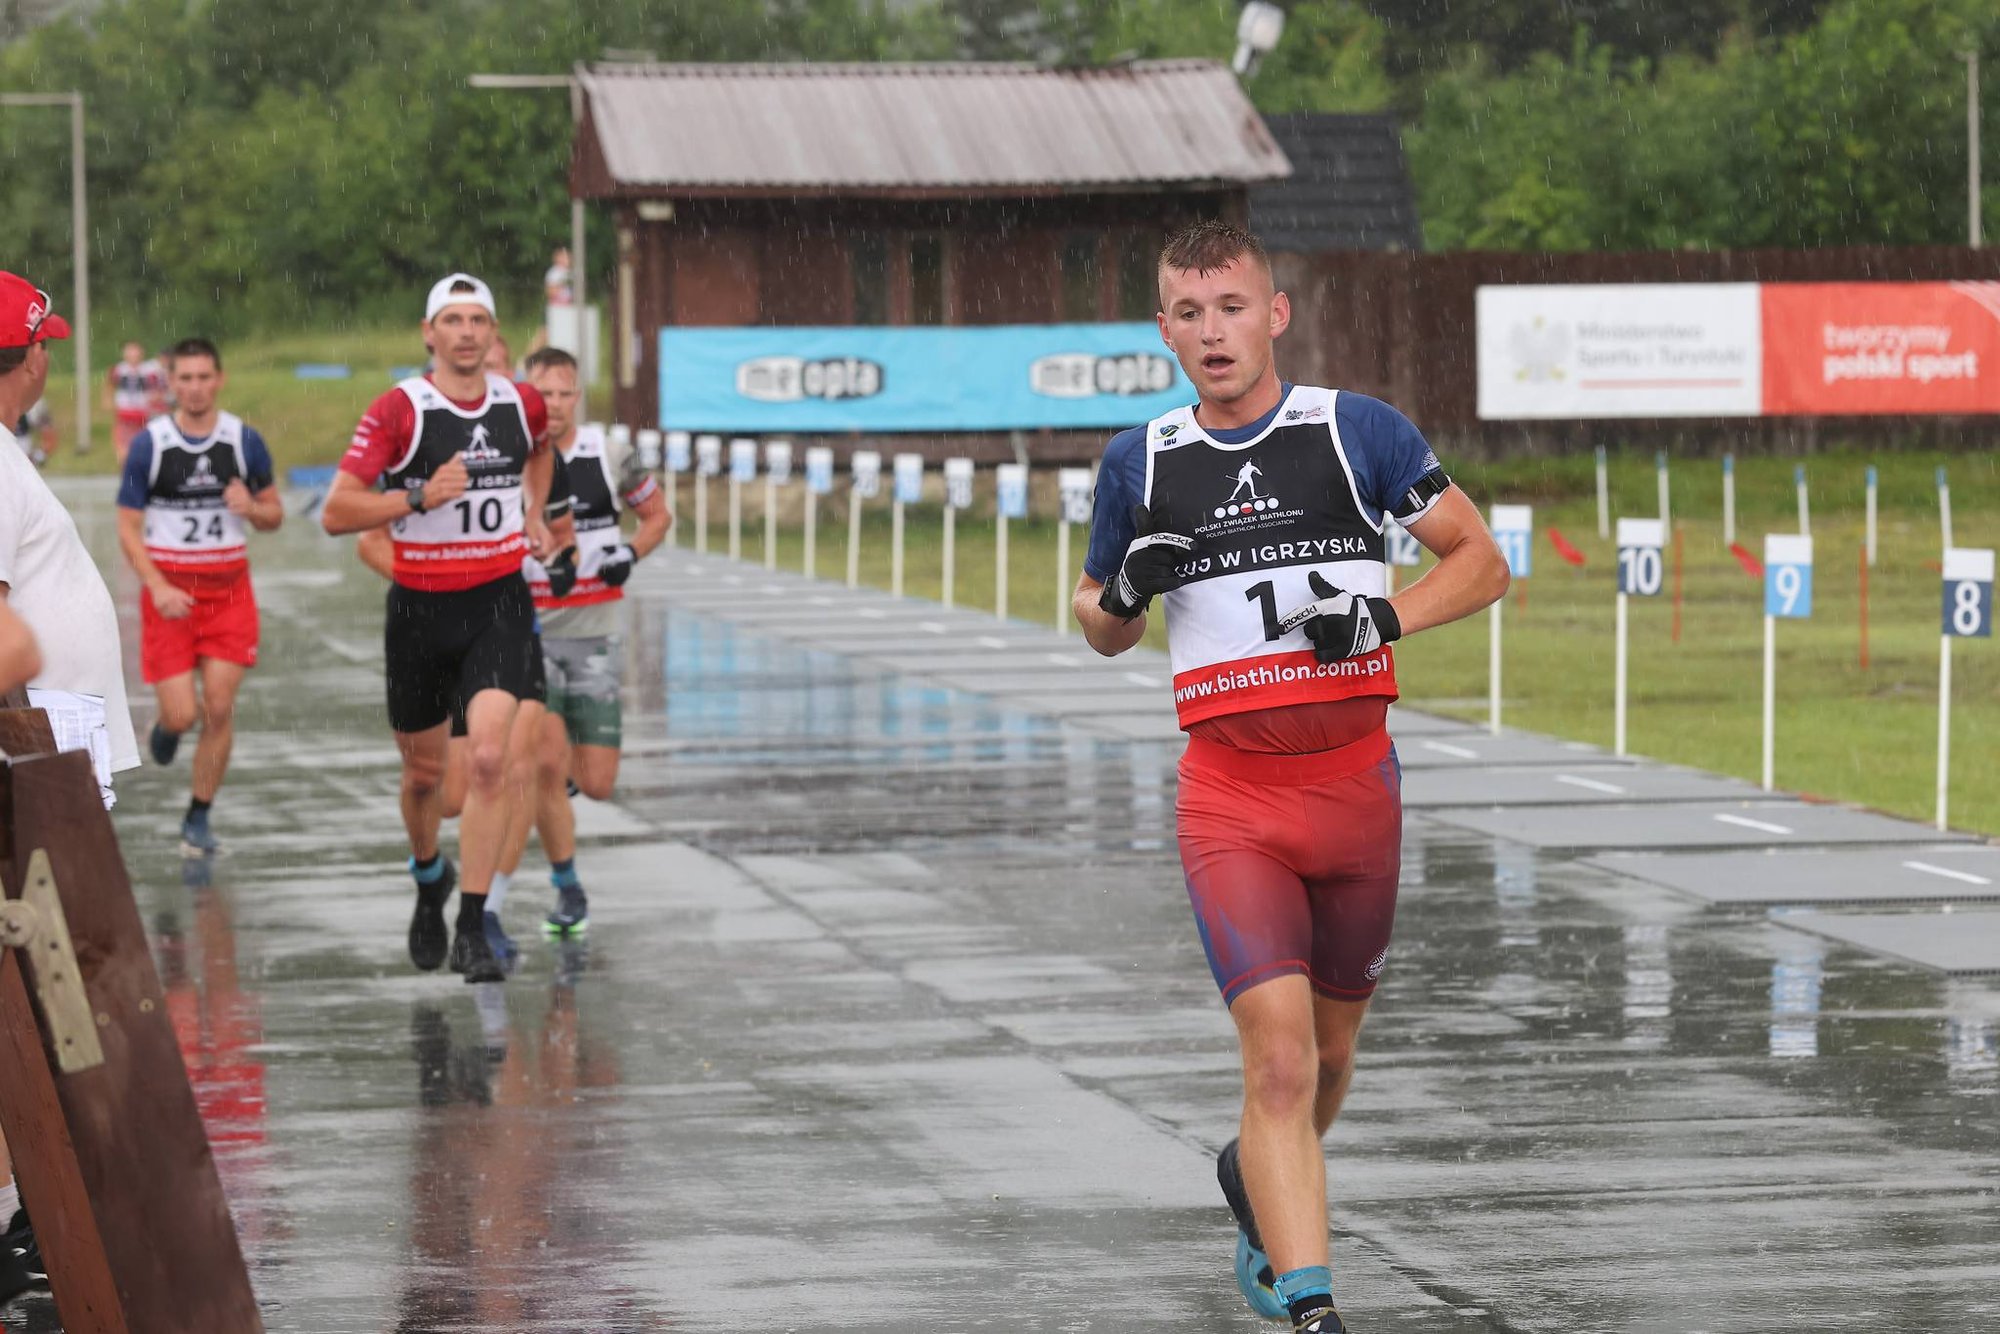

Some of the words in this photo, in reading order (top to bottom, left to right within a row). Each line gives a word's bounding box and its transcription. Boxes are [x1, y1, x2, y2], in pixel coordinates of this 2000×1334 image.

[1823, 321, 1951, 352] tworzymy
[1823, 350, 1904, 384] polski
[1908, 350, 1978, 384] sport
[1164, 437, 1177, 447] IBU
[183, 514, 223, 543] 24
[455, 498, 502, 533] 10
[1194, 522, 1222, 535] POLSKI
[1223, 515, 1257, 528] ZWIĄZEK
[1260, 509, 1304, 520] BIATHLONU
[1205, 530, 1227, 539] POLISH
[1227, 524, 1256, 535] BIATHLON
[1257, 519, 1295, 529] ASSOCIATION
[1218, 550, 1241, 568] W
[1251, 536, 1367, 564] IGRZYSKA
[1619, 548, 1662, 595] 10
[1775, 565, 1801, 615] 9
[1245, 580, 1280, 642] 1
[1953, 580, 1982, 636] 8
[1175, 653, 1388, 703] www.biathlon.com.pl
